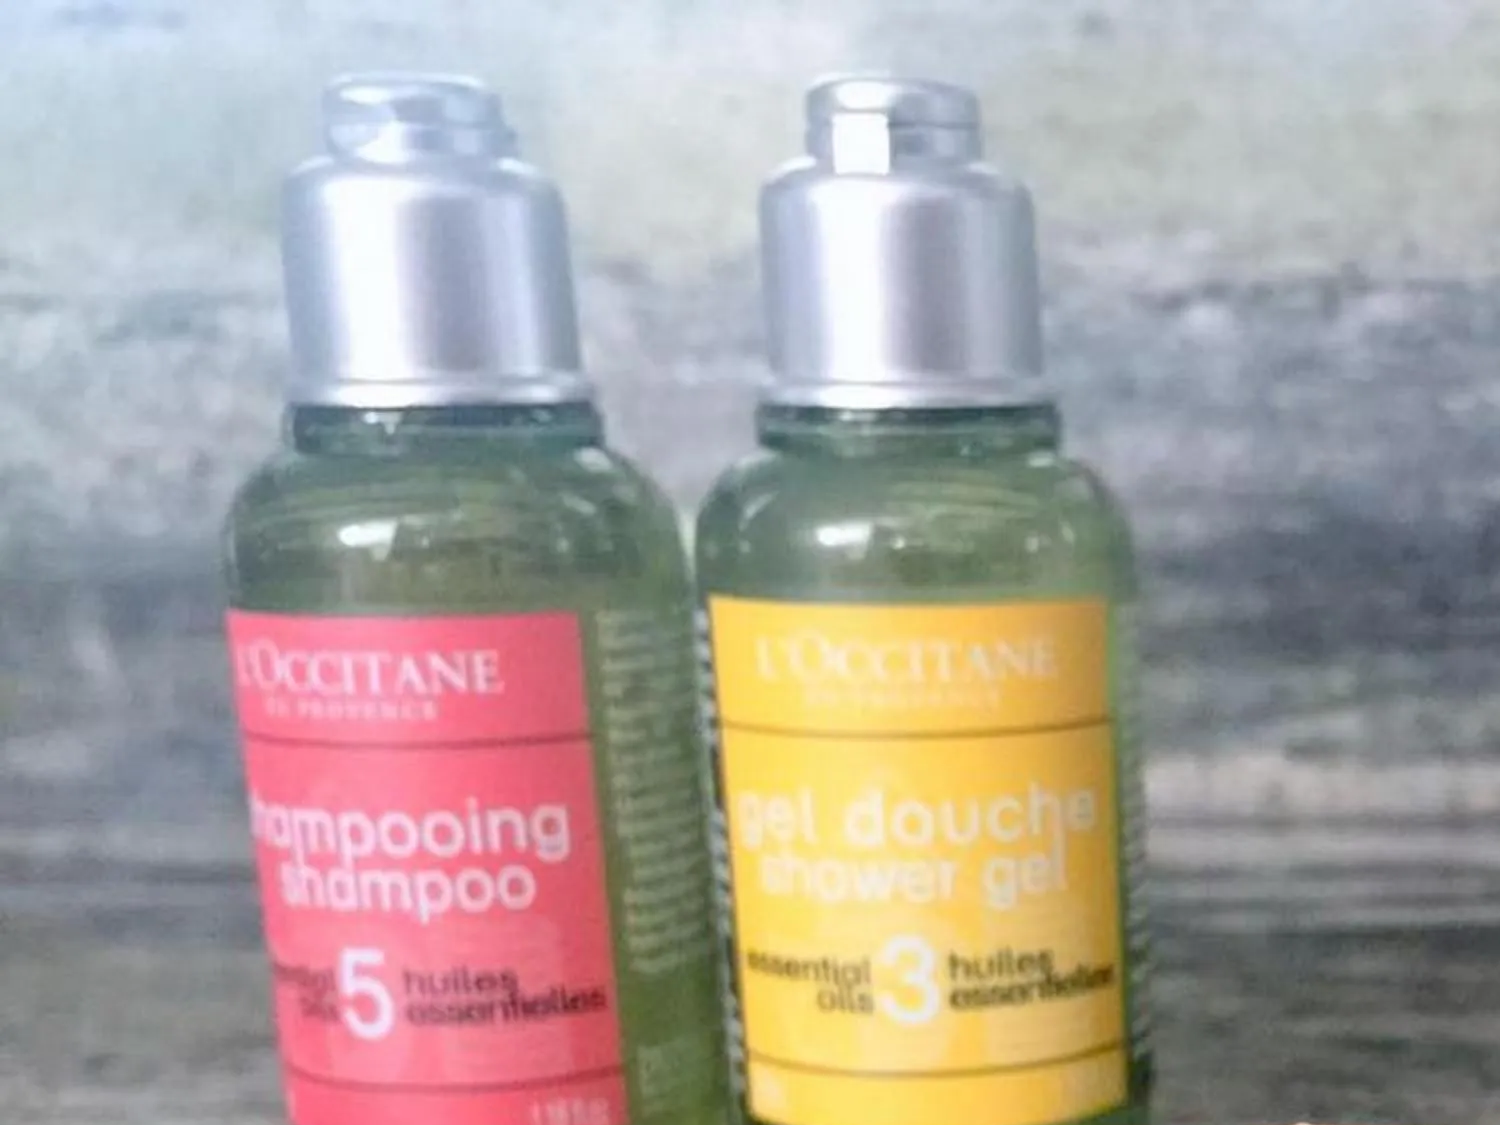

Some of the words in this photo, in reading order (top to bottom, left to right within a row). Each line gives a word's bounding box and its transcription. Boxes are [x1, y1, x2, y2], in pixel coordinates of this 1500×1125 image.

[738, 788, 816, 848] gel
[842, 782, 1098, 848] douche
[280, 862, 537, 926] shampoo
[761, 850, 958, 904] shower
[983, 840, 1068, 912] gel
[338, 947, 395, 1041] 5
[876, 933, 941, 1024] 3
